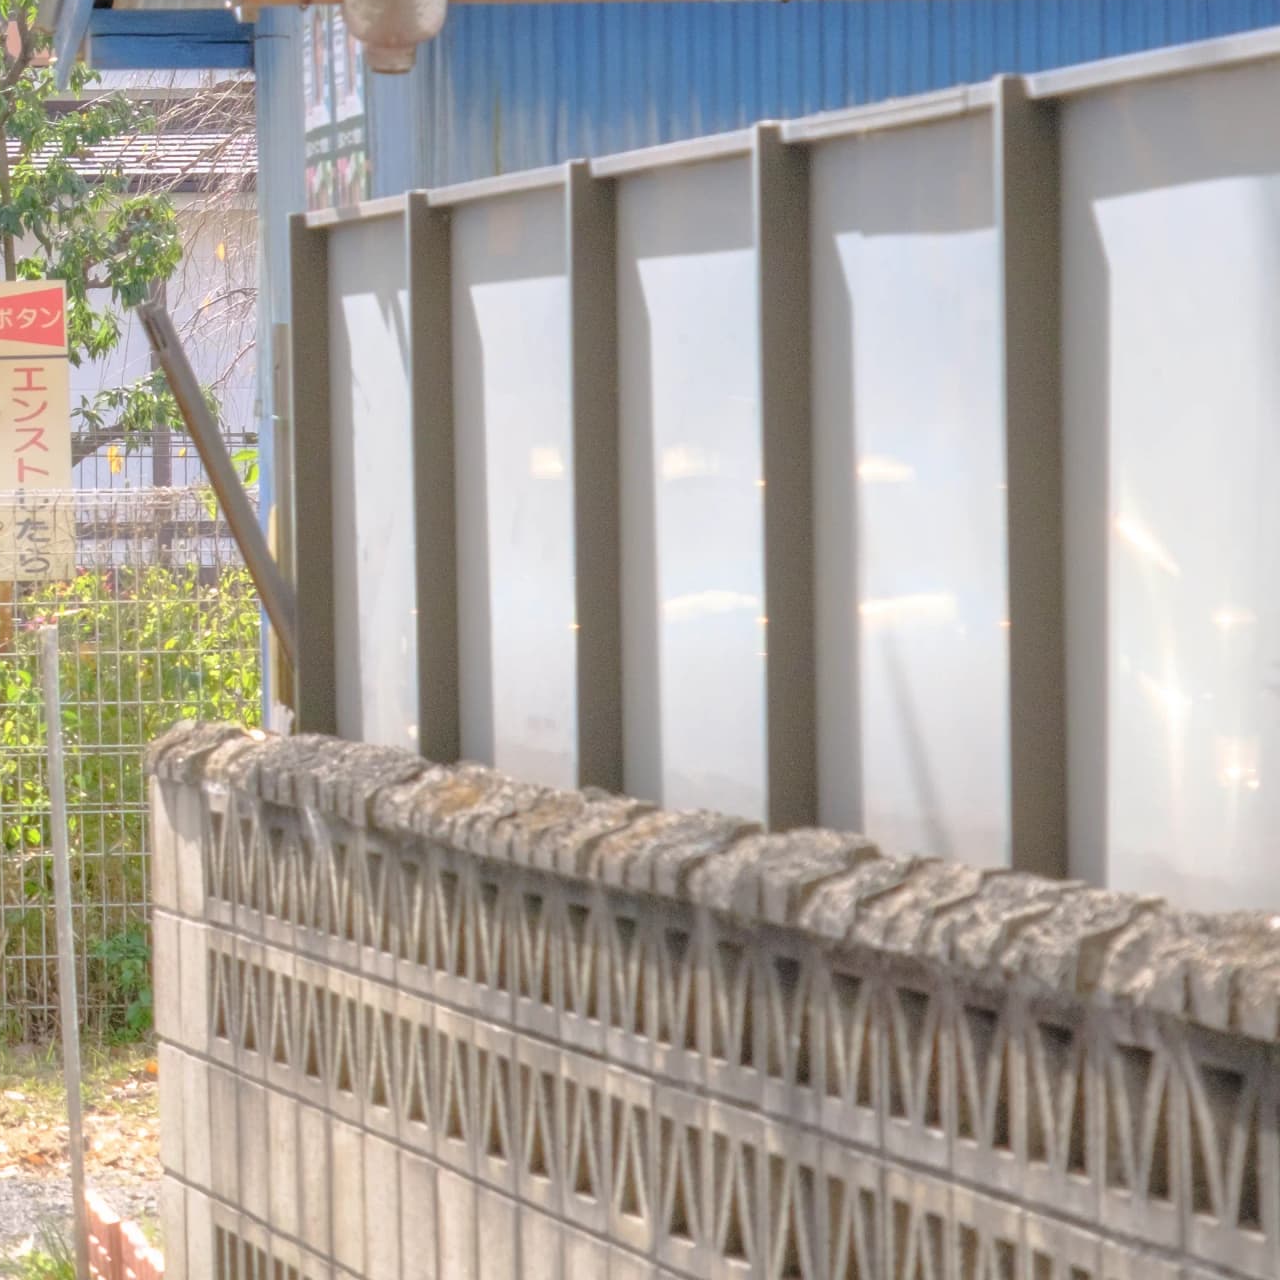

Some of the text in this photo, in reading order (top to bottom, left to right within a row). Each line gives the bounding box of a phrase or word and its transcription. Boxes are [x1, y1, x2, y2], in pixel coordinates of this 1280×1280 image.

[11, 367, 50, 574] エンストしたら
